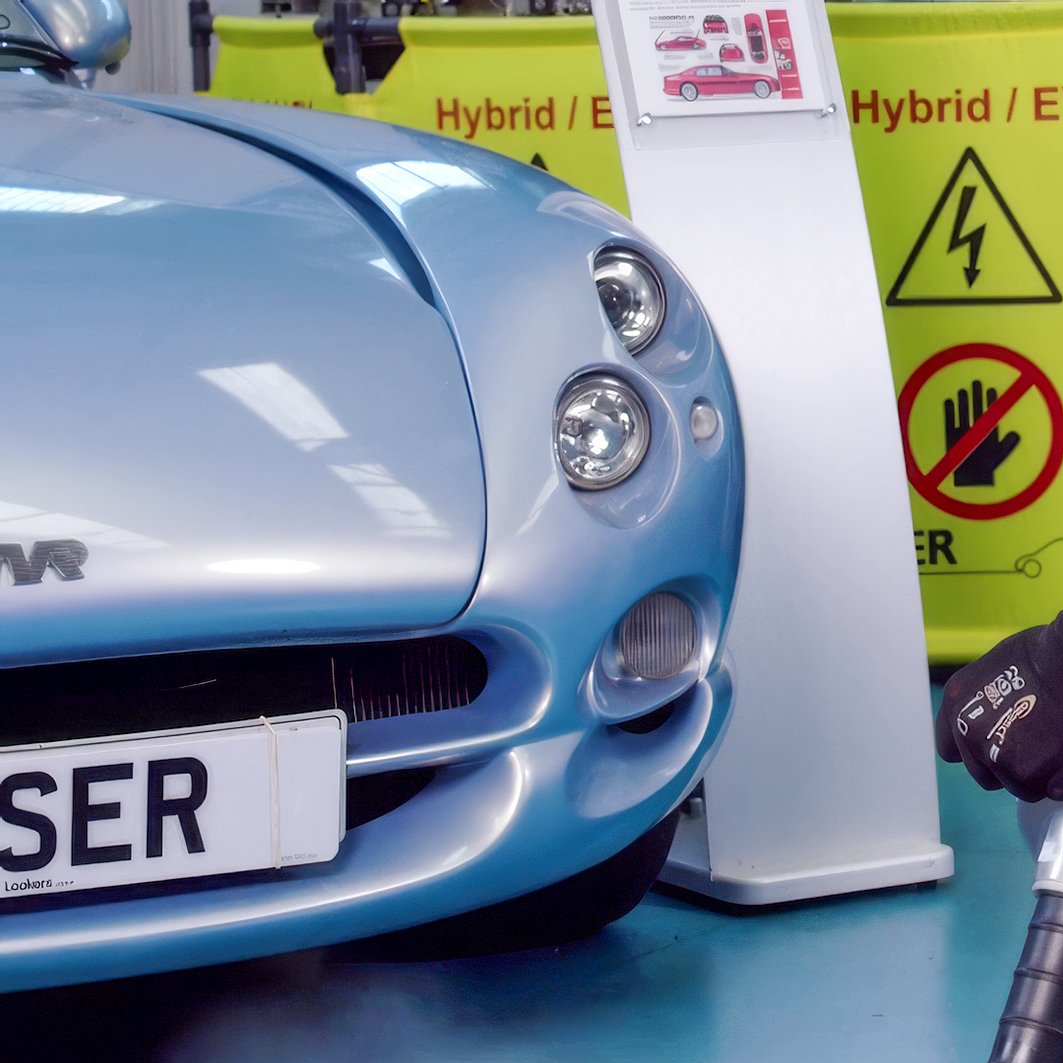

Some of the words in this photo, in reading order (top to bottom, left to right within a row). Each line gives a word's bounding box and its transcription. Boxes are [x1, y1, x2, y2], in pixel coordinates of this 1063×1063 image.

[436, 96, 555, 139] Hybrid
[851, 88, 991, 133] Hybrid
[0, 539, 88, 586] VR
[0, 756, 208, 872] SER
